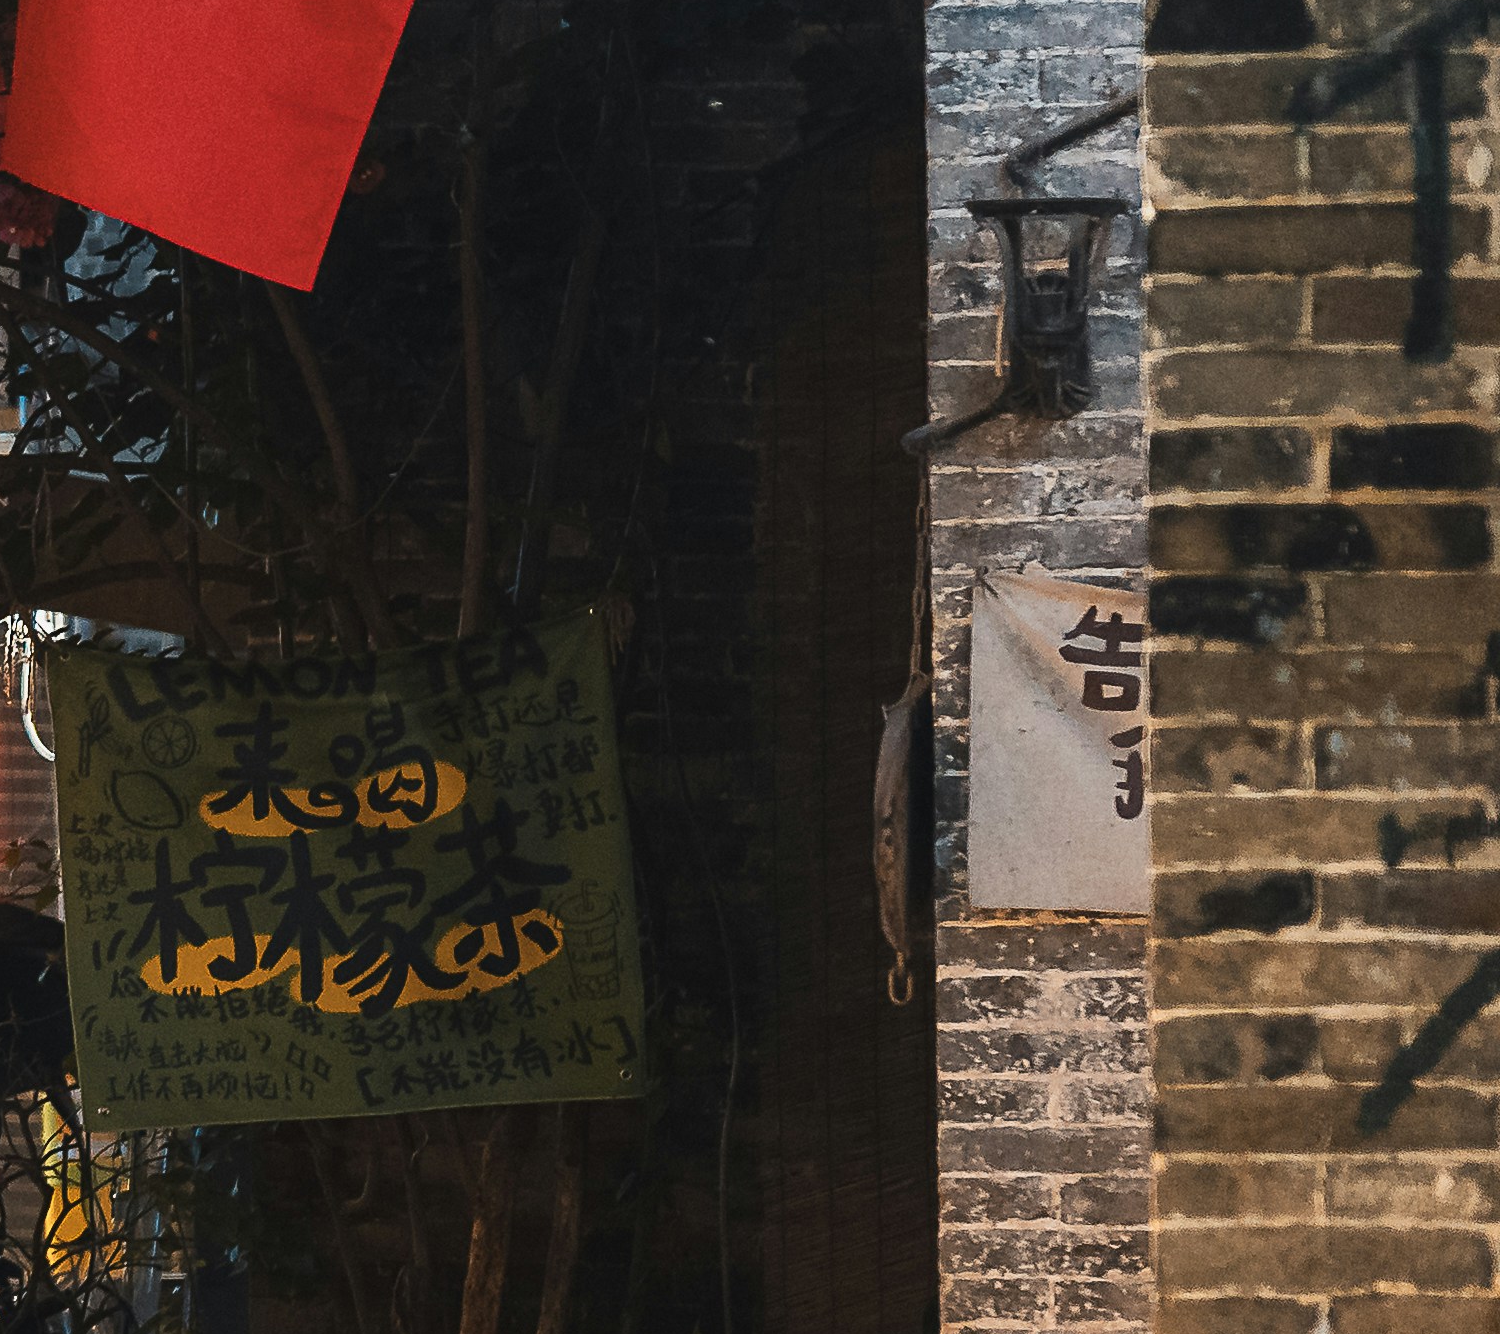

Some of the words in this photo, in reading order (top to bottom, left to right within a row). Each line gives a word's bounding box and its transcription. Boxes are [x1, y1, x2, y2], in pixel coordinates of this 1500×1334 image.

[106, 649, 378, 721] LEMON
[417, 627, 549, 696] TEA
[114, 804, 573, 1018] 柠檬茶
